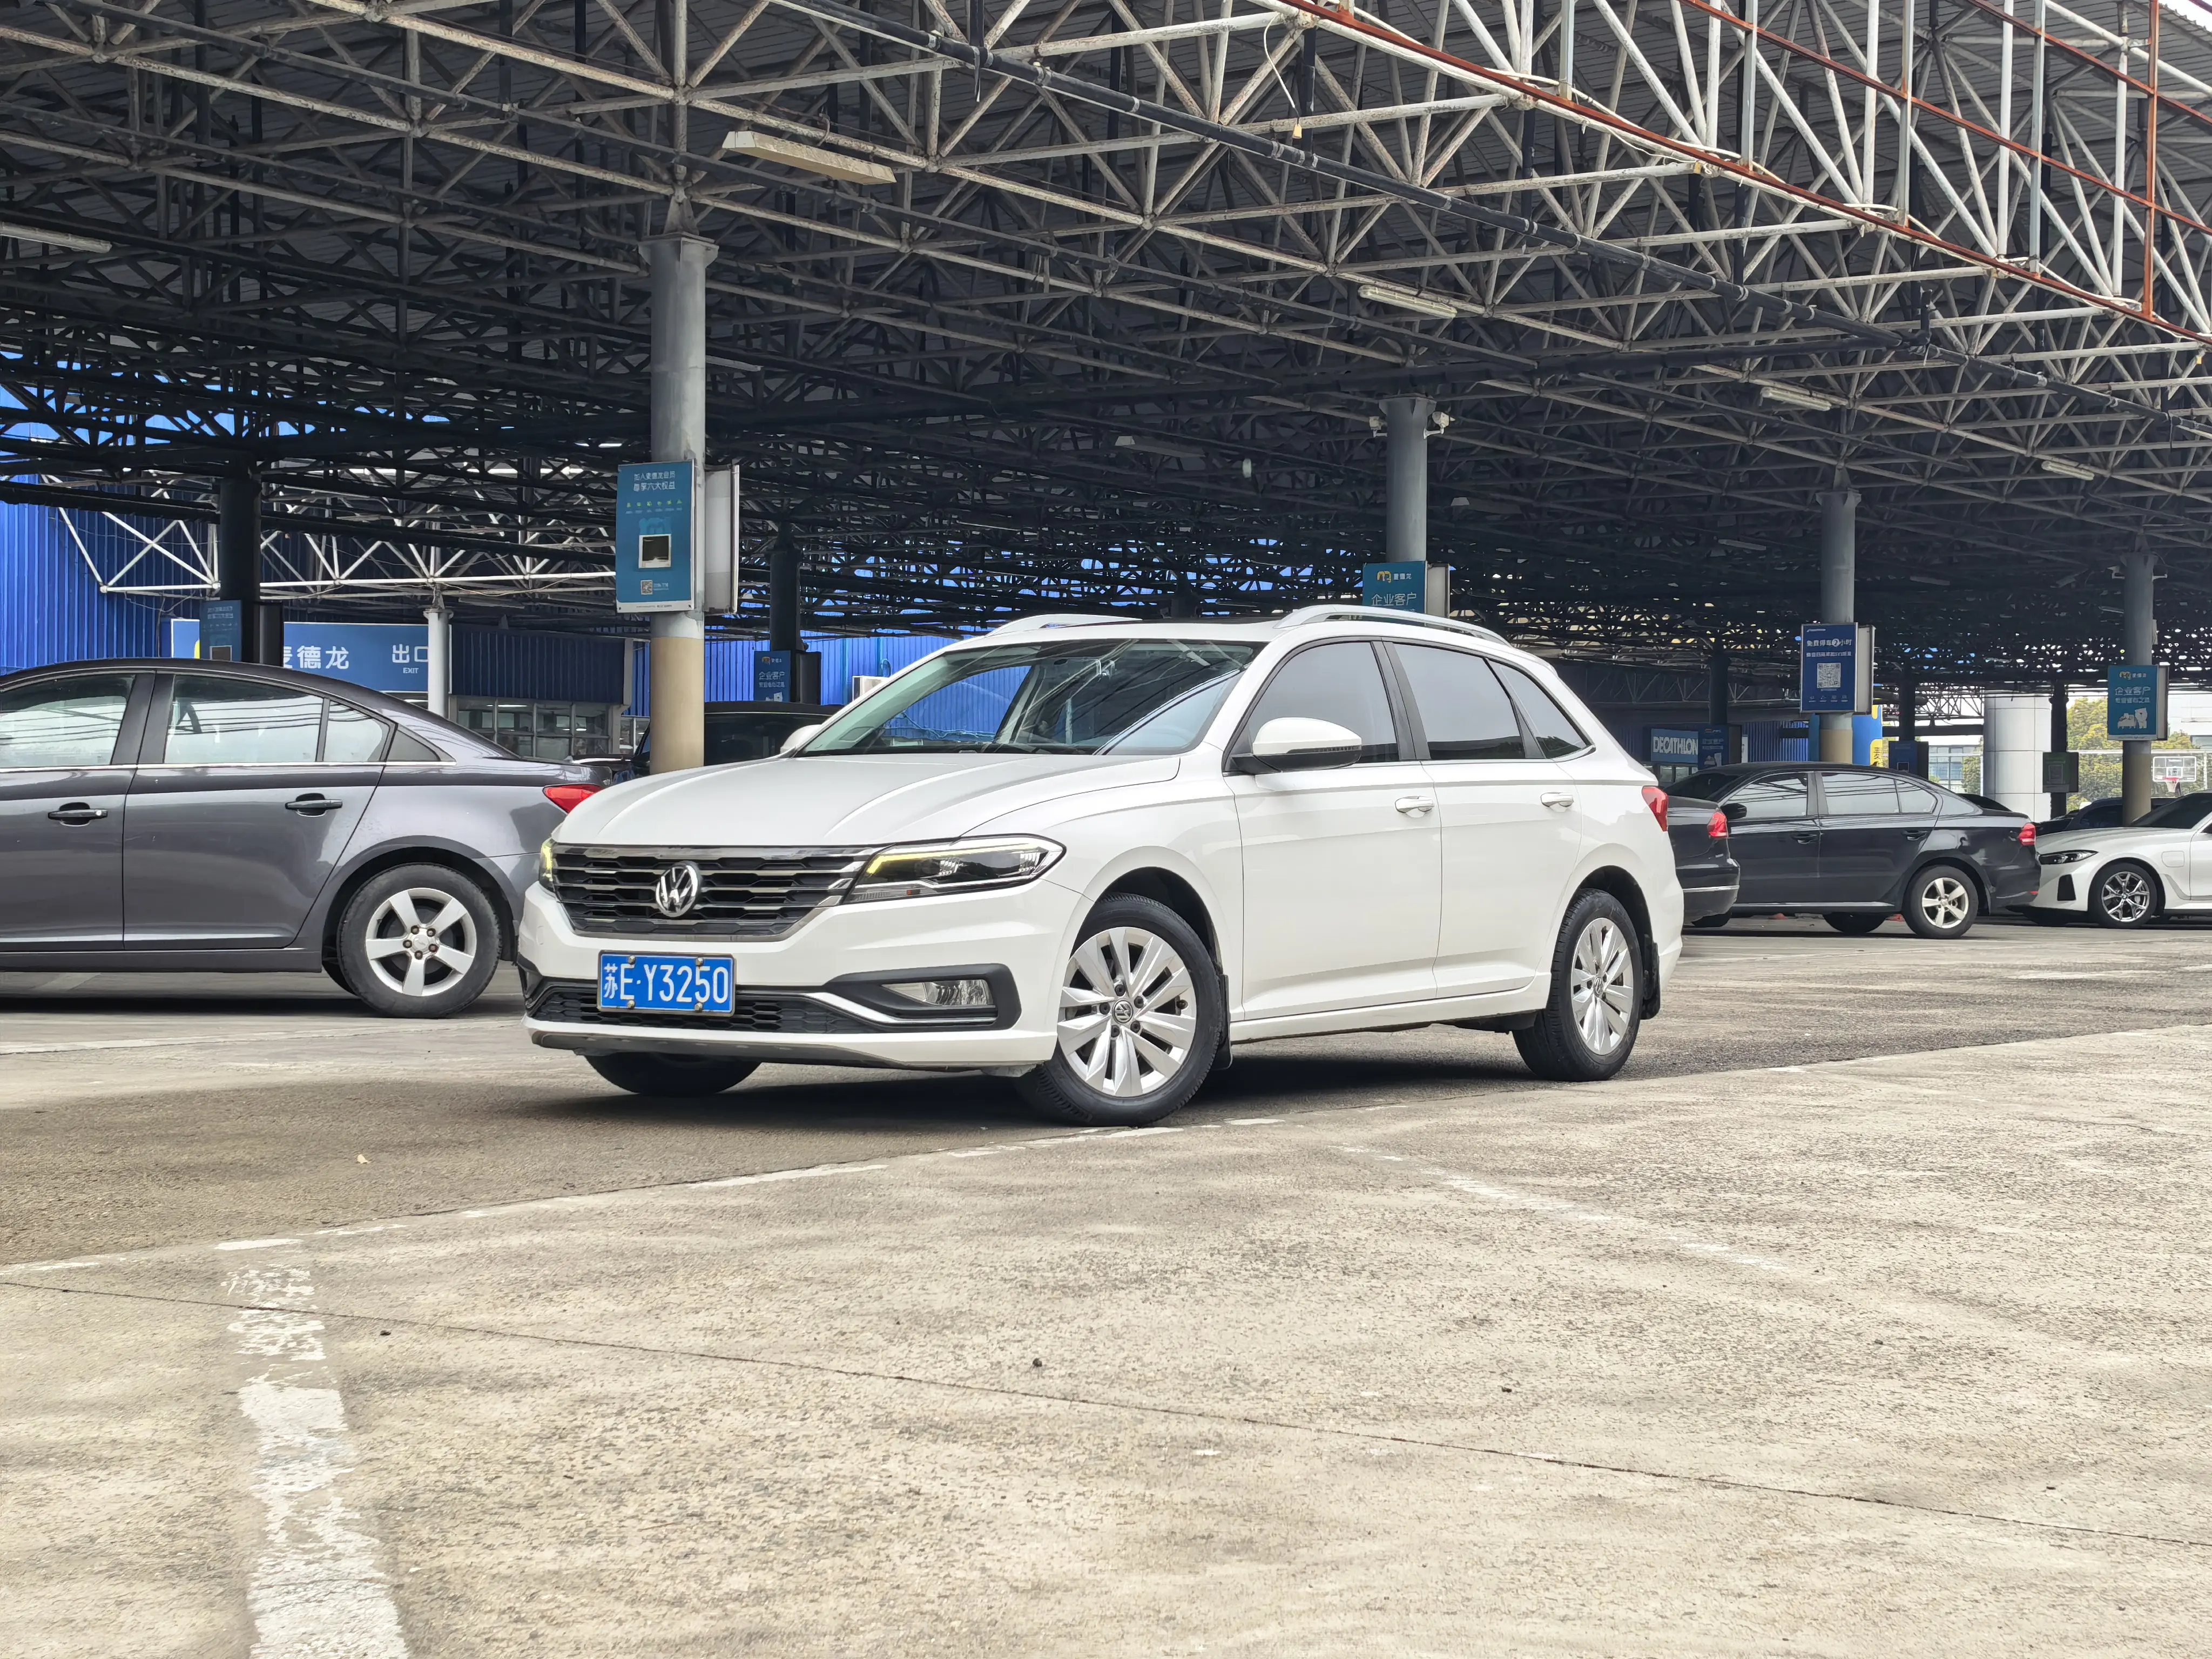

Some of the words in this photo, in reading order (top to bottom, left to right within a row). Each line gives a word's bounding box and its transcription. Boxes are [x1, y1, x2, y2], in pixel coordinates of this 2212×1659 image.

[1371, 591, 1417, 606] 企业客户
[392, 644, 429, 663] 出口
[1653, 736, 1698, 756] DECATHLON
